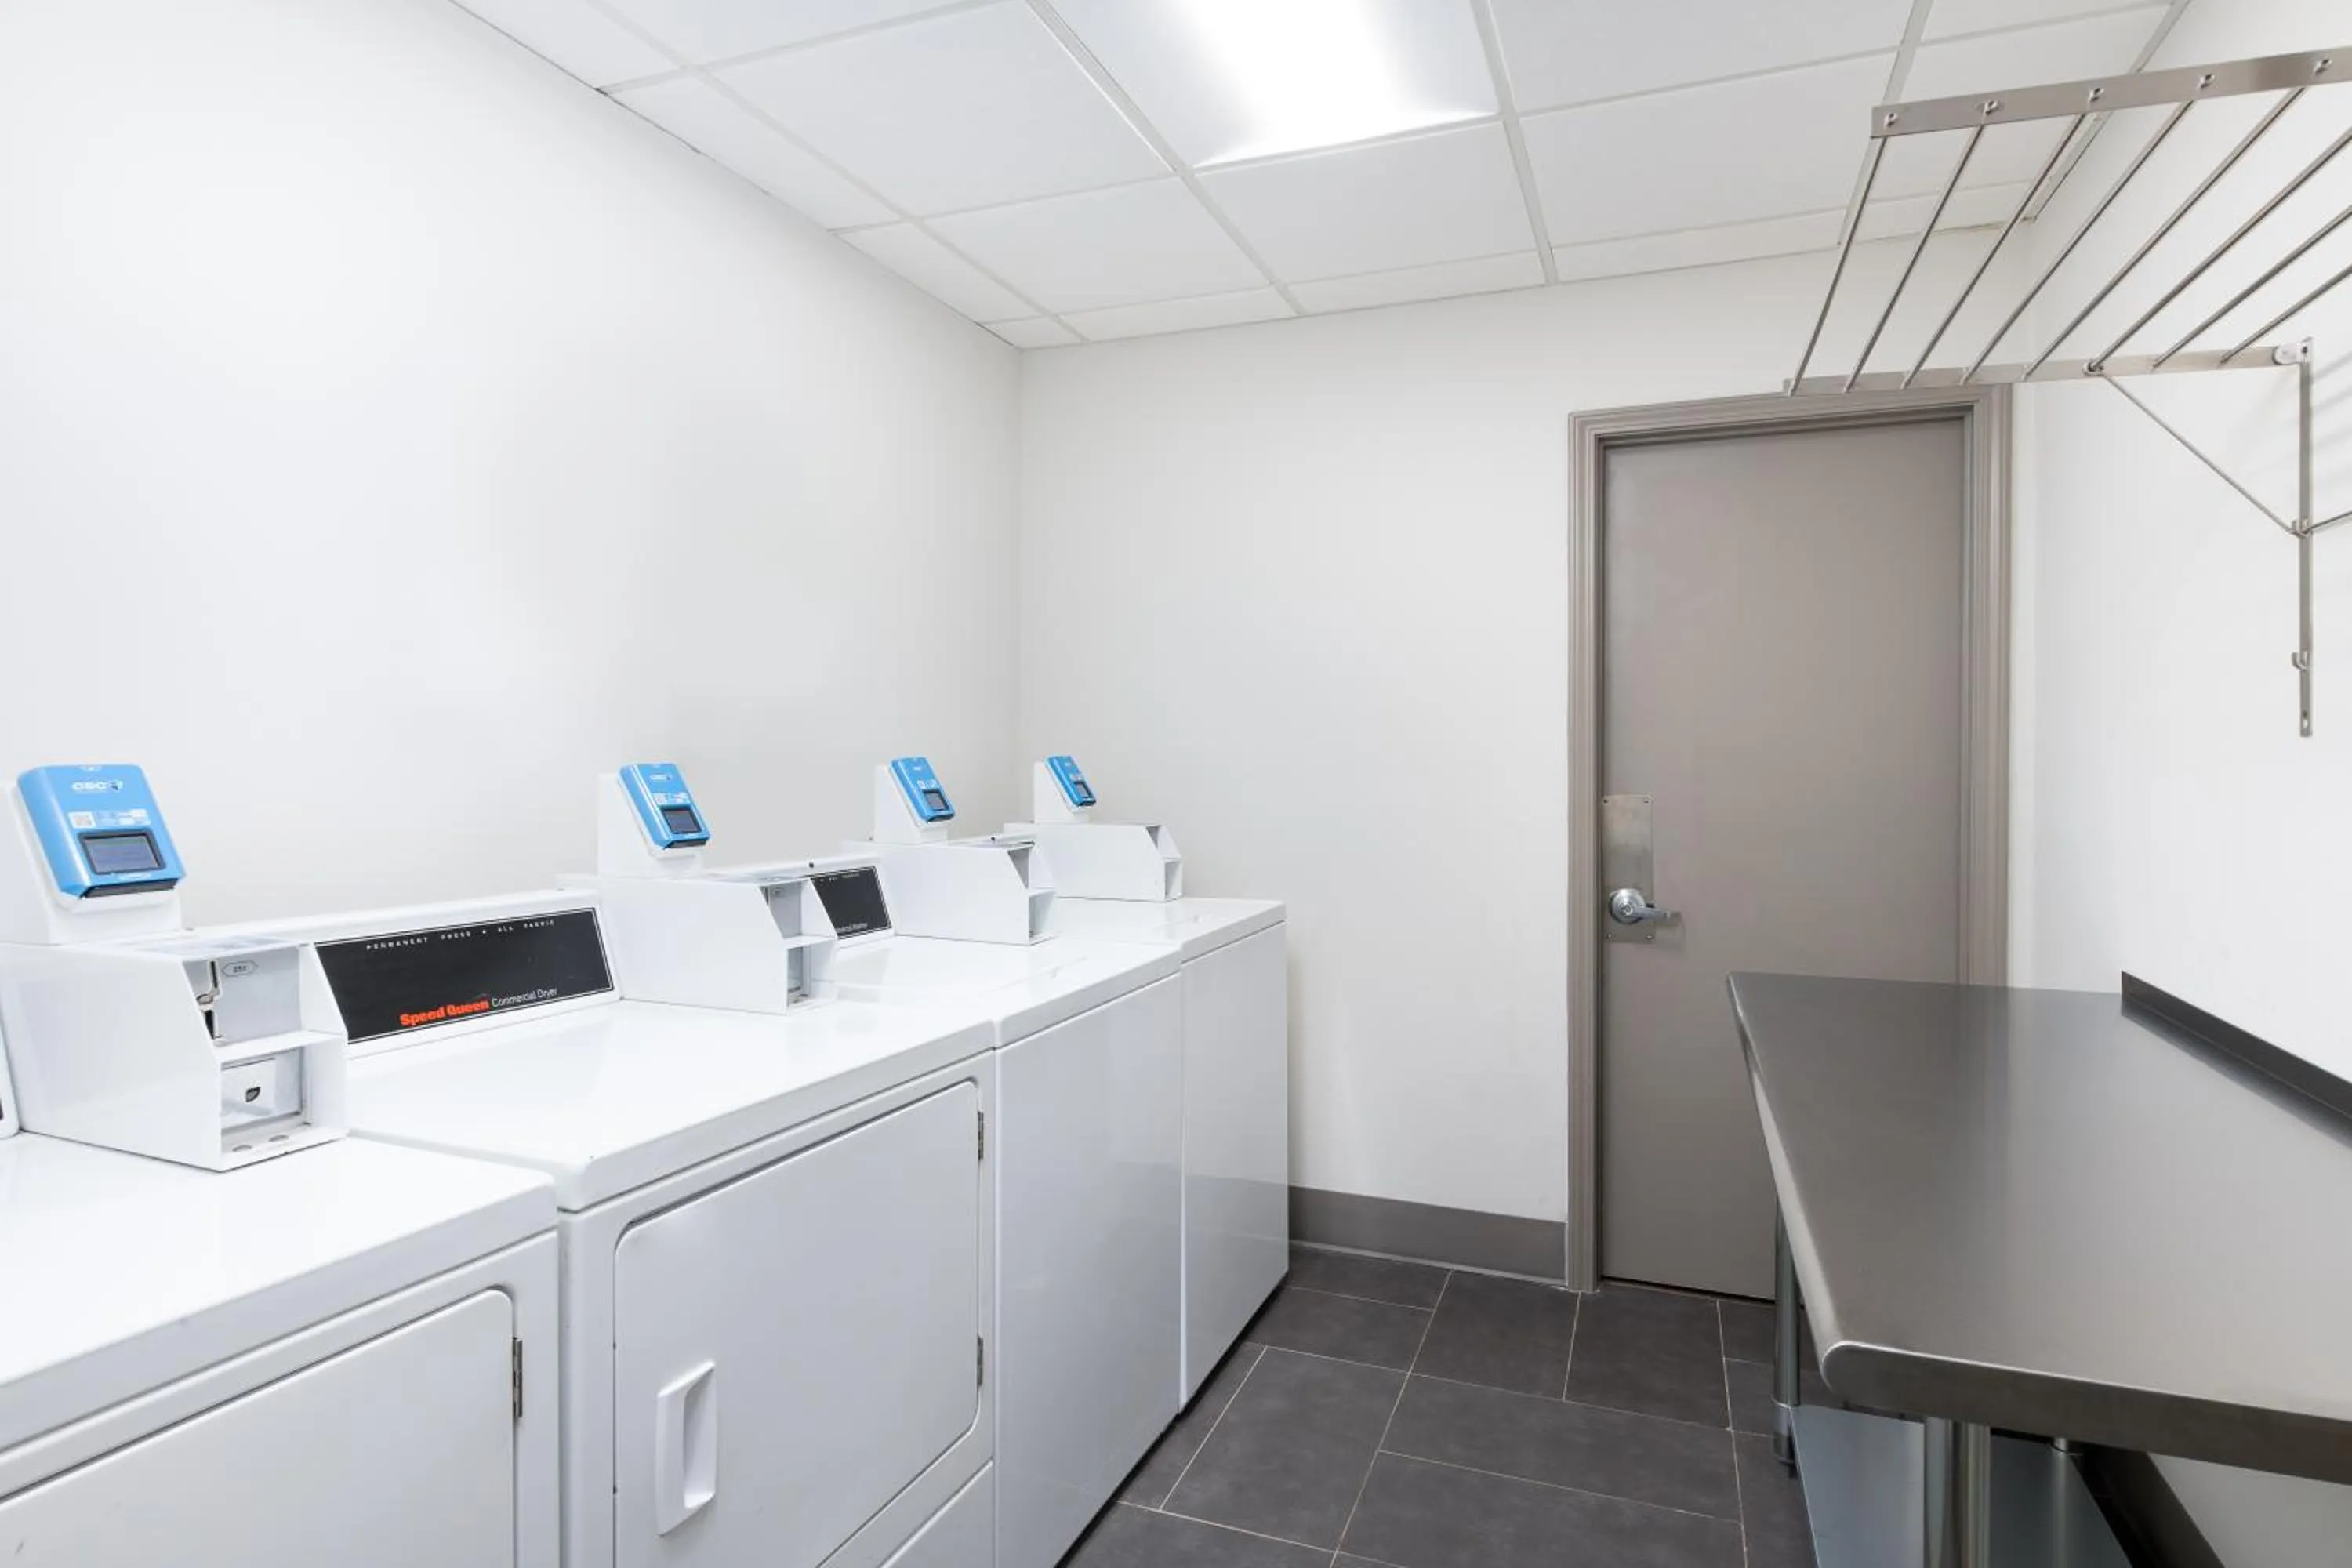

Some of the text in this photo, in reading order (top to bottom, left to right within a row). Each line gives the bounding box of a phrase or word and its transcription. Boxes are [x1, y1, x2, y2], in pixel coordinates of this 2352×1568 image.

[400, 988, 558, 1026] Speed Queen Commercial Dryer
